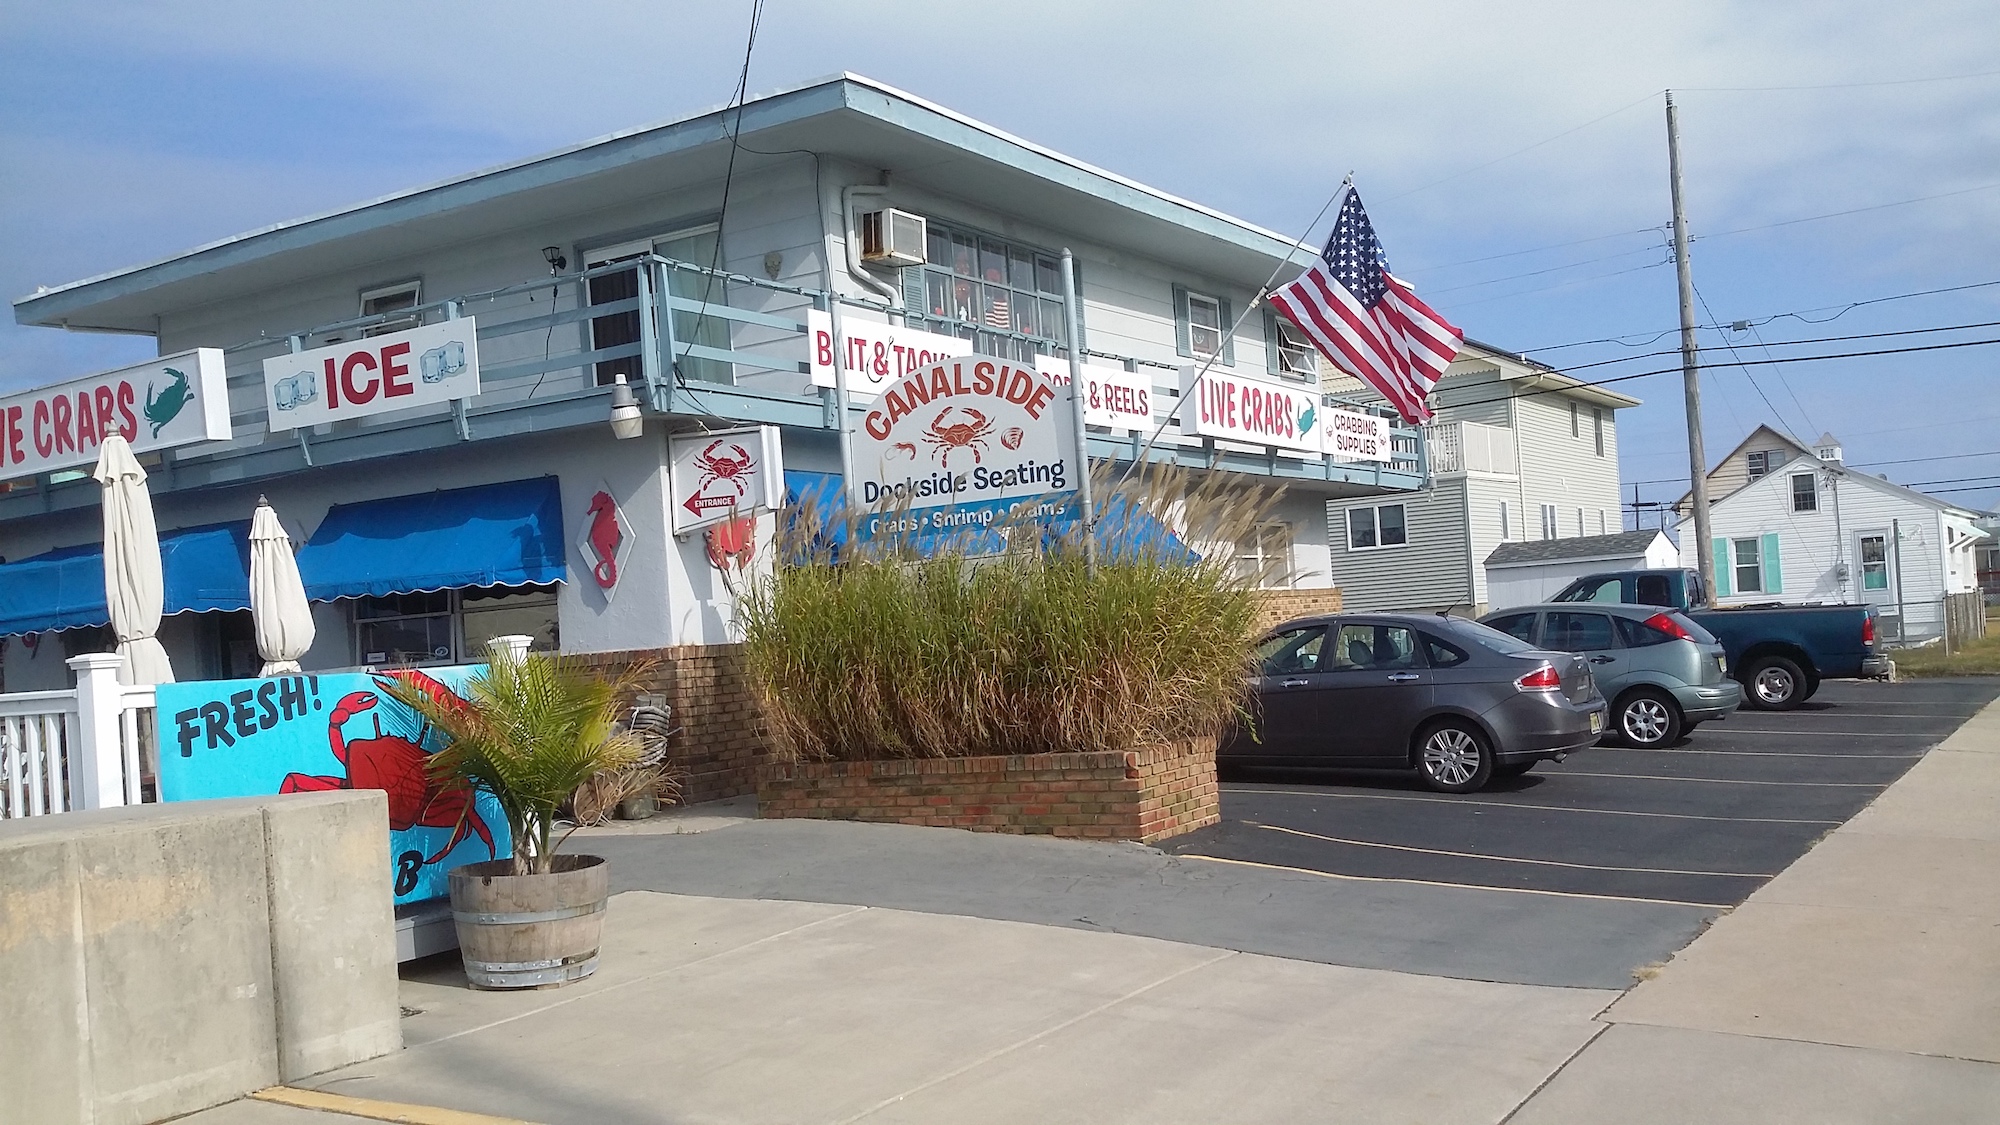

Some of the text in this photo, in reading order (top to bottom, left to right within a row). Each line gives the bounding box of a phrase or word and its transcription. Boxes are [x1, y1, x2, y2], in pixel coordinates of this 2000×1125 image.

[324, 341, 414, 410] ICE
[873, 341, 890, 376] &
[33, 380, 138, 458] CRABS
[865, 361, 1056, 441] CANALSIDE
[1089, 381, 1101, 409] &
[1104, 383, 1149, 416] REELS
[1200, 377, 1293, 439] LIVE CRABS
[1334, 414, 1377, 437] CRABBING
[1336, 434, 1377, 456] SUPPLIES
[694, 497, 733, 508] ENTRANCE
[864, 460, 1066, 503] Dockside Seating
[175, 675, 323, 758] FRESH!
